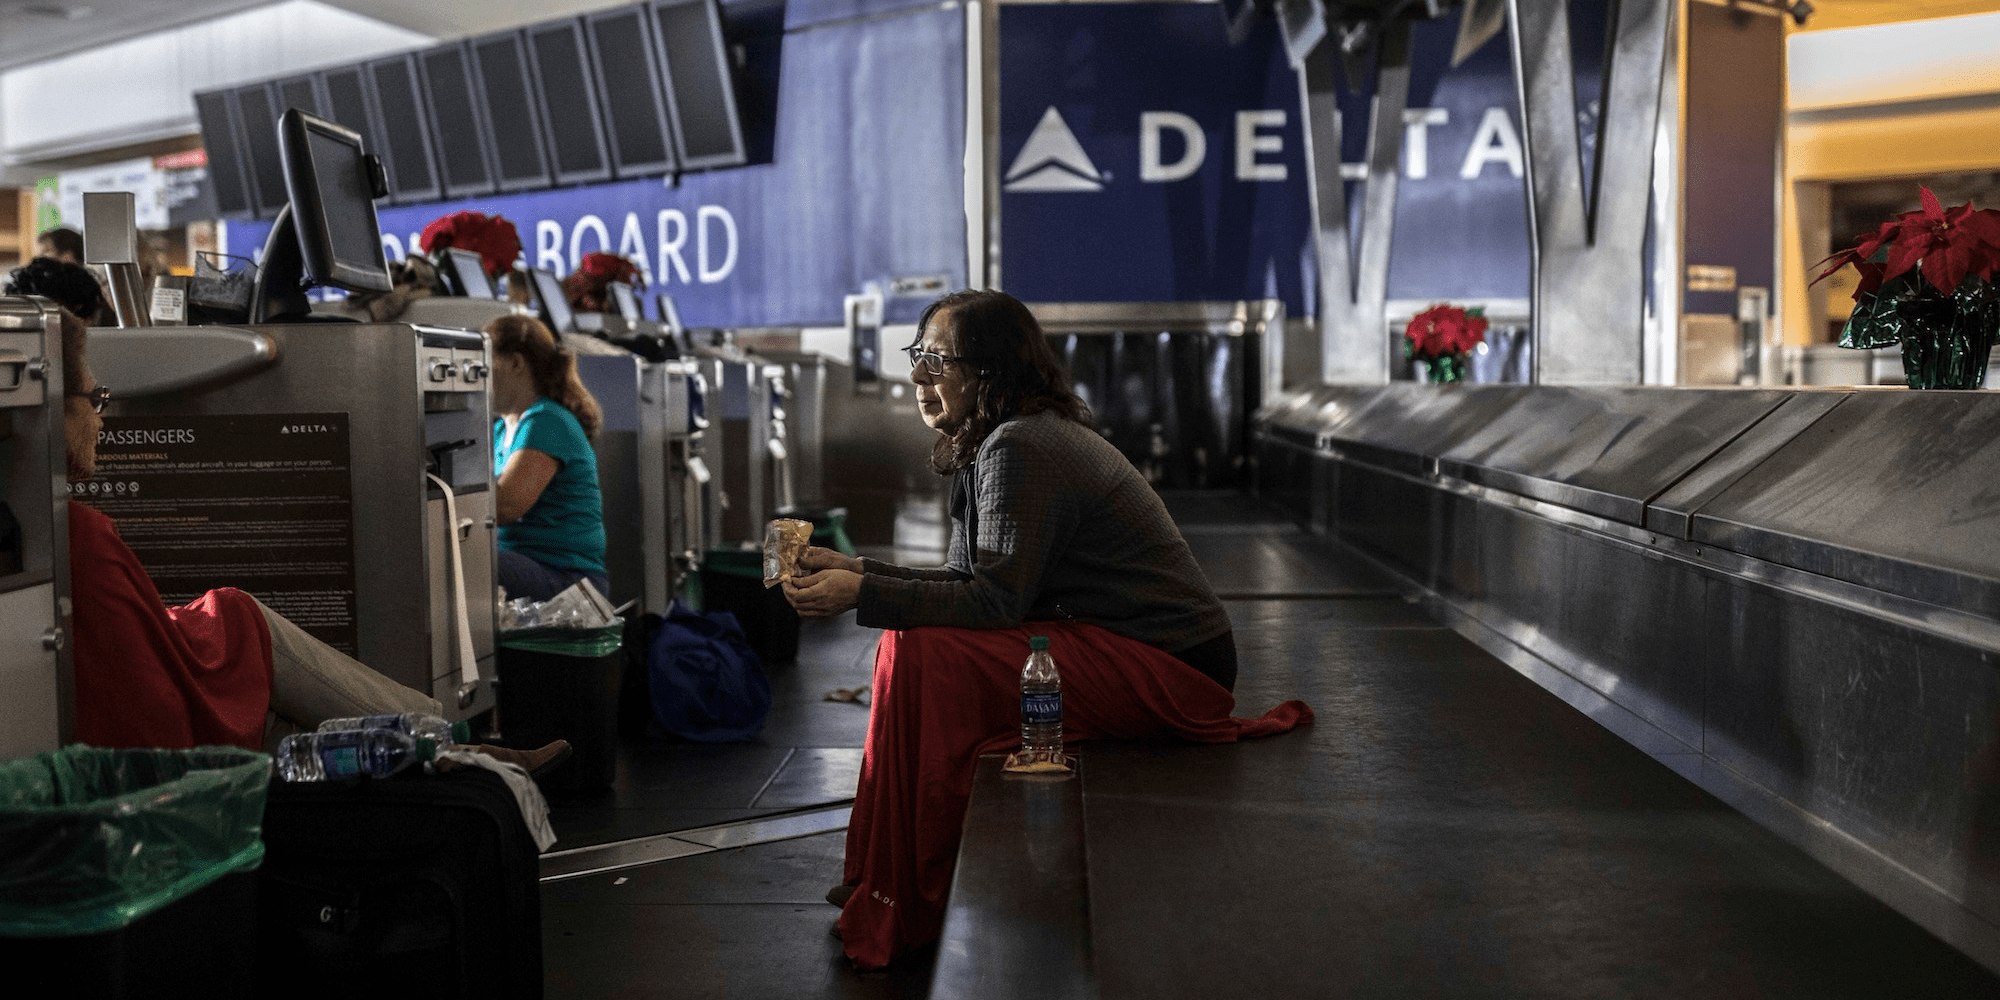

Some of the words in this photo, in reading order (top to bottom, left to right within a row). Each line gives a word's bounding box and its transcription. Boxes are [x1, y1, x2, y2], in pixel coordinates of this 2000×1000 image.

[536, 204, 738, 285] BOARD
[292, 425, 328, 433] DELTA
[97, 429, 195, 444] PASSENGERS
[1026, 703, 1059, 713] DASANI
